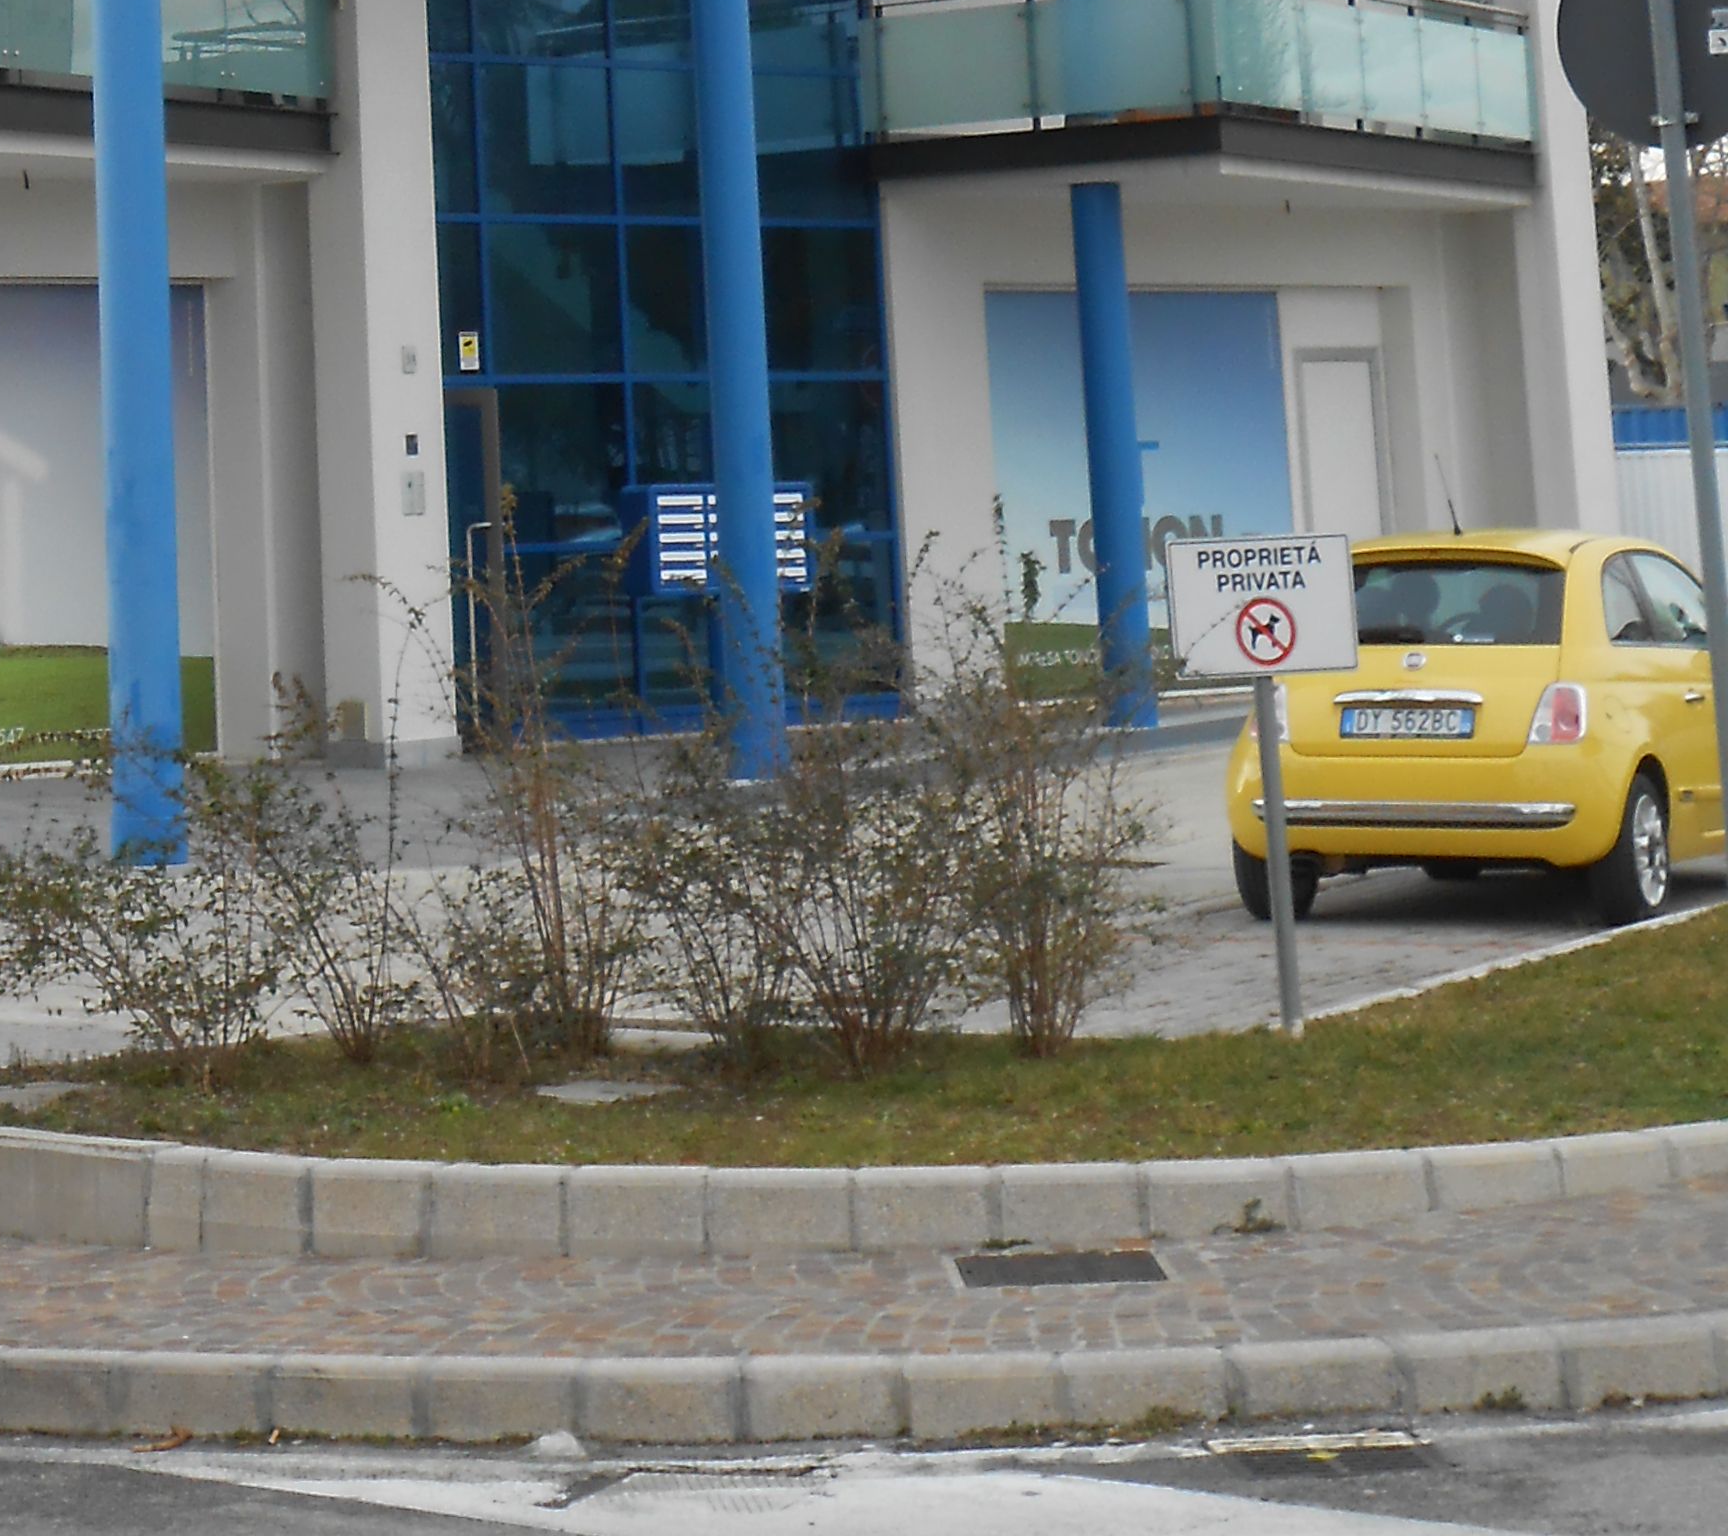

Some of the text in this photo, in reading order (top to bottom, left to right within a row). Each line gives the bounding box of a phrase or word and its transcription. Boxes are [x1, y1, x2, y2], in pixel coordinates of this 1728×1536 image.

[1216, 571, 1306, 592] PRIVATA
[1356, 710, 1458, 732] DY 562BC
